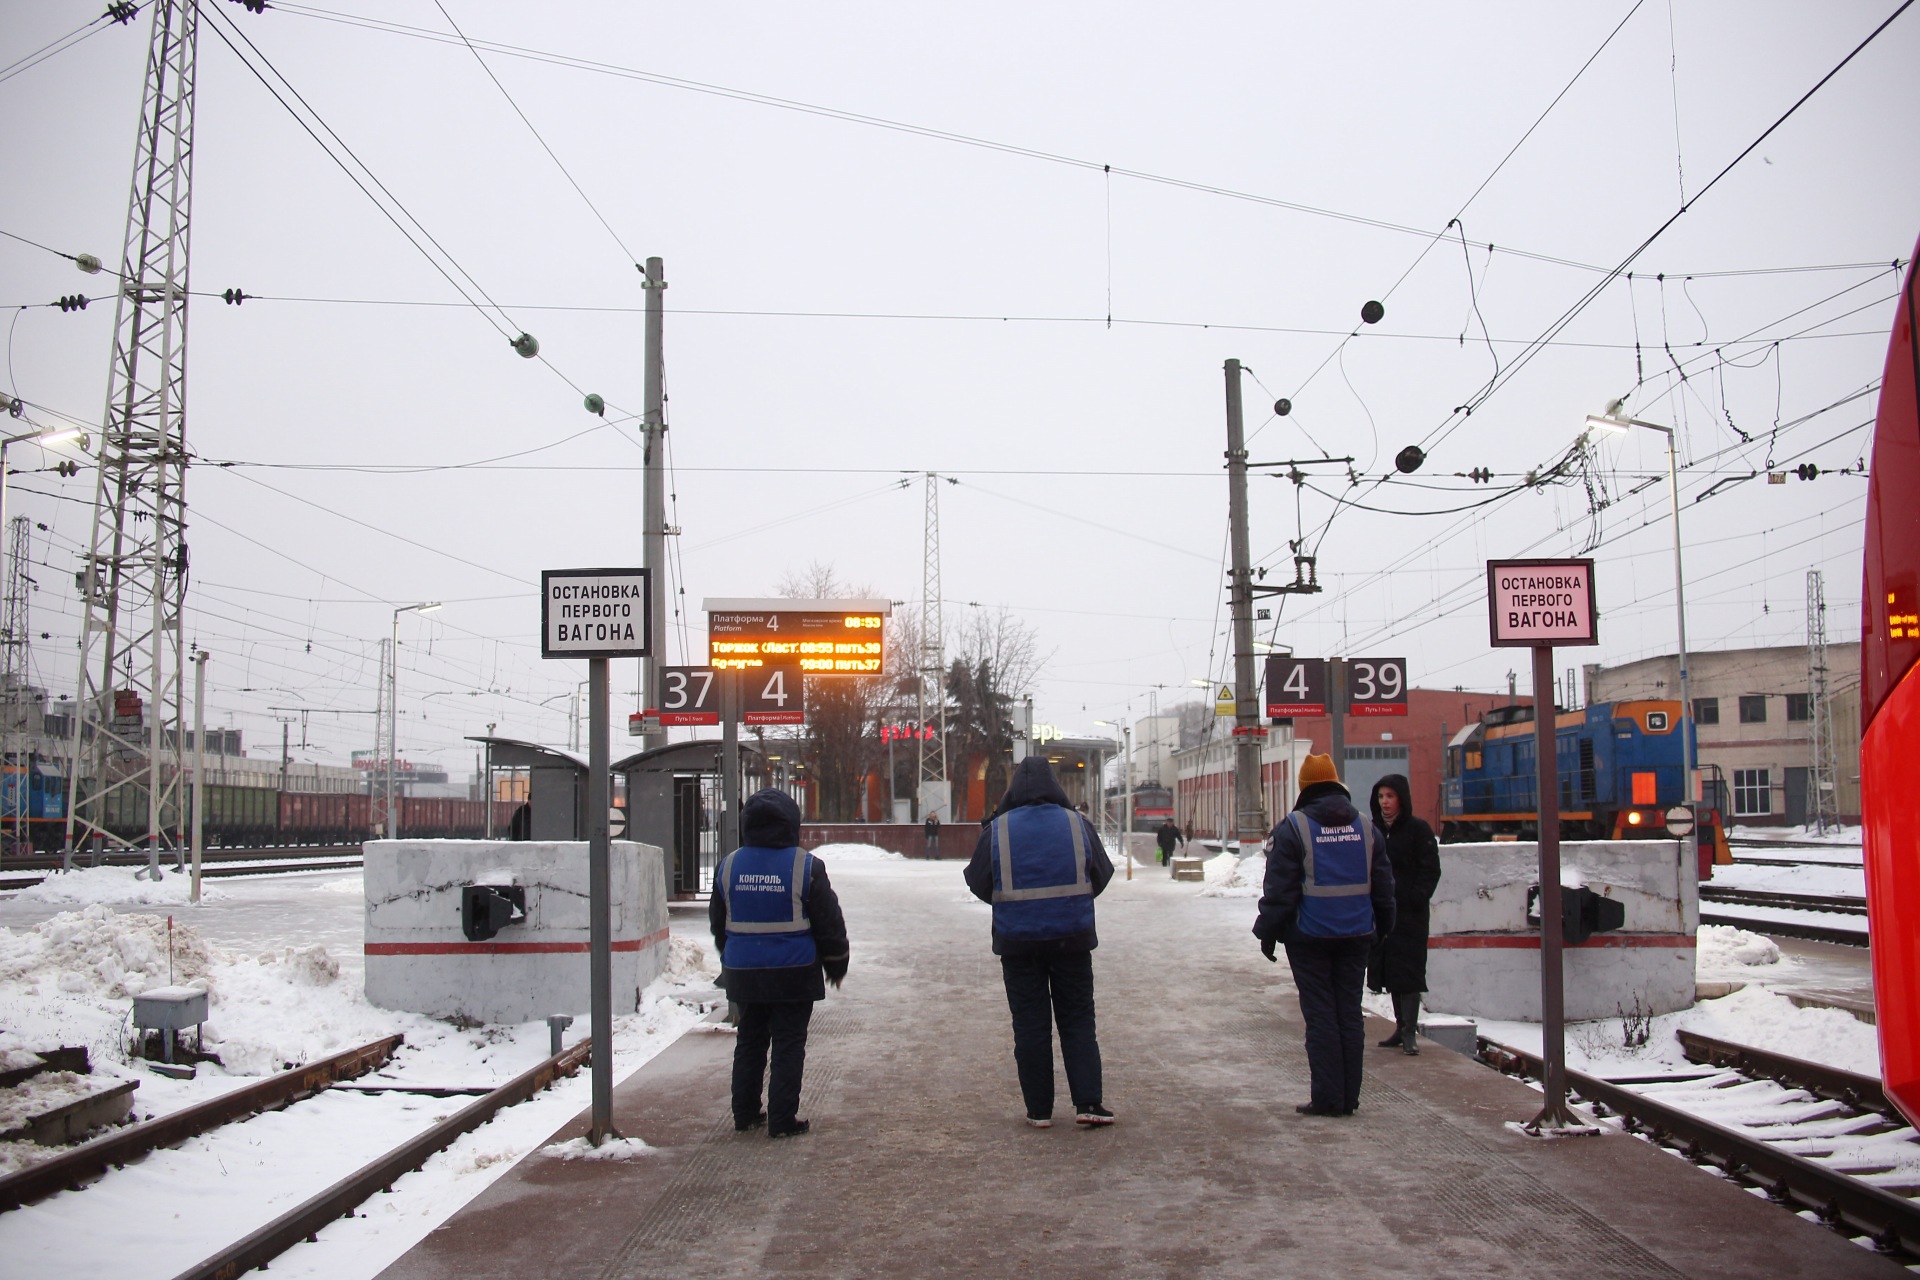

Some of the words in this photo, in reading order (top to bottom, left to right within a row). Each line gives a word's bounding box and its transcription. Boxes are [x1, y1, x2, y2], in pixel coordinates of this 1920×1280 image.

[1501, 577, 1581, 590] ОСТАНОВКА
[552, 585, 640, 599] ОСТАНОВКА
[1512, 594, 1573, 607] ПЕРВОГО
[562, 604, 631, 618] ПЕРВОГО
[713, 614, 764, 624] Платформа
[766, 614, 779, 632] 4
[844, 616, 881, 628] 08:53
[1508, 611, 1578, 628] ВАГОНА
[558, 623, 635, 642] ВАГОНА
[711, 642, 759, 653] Торжок
[1283, 664, 1310, 700] 4
[1353, 663, 1402, 700] 39
[664, 671, 714, 709] 37
[761, 671, 788, 707] 4
[1032, 724, 1064, 745] ерь
[1321, 825, 1354, 834] КОНТРОЛЬ
[1338, 834, 1361, 842] ПРОЕЗДА
[739, 874, 781, 884] КОНТРОЛЬ
